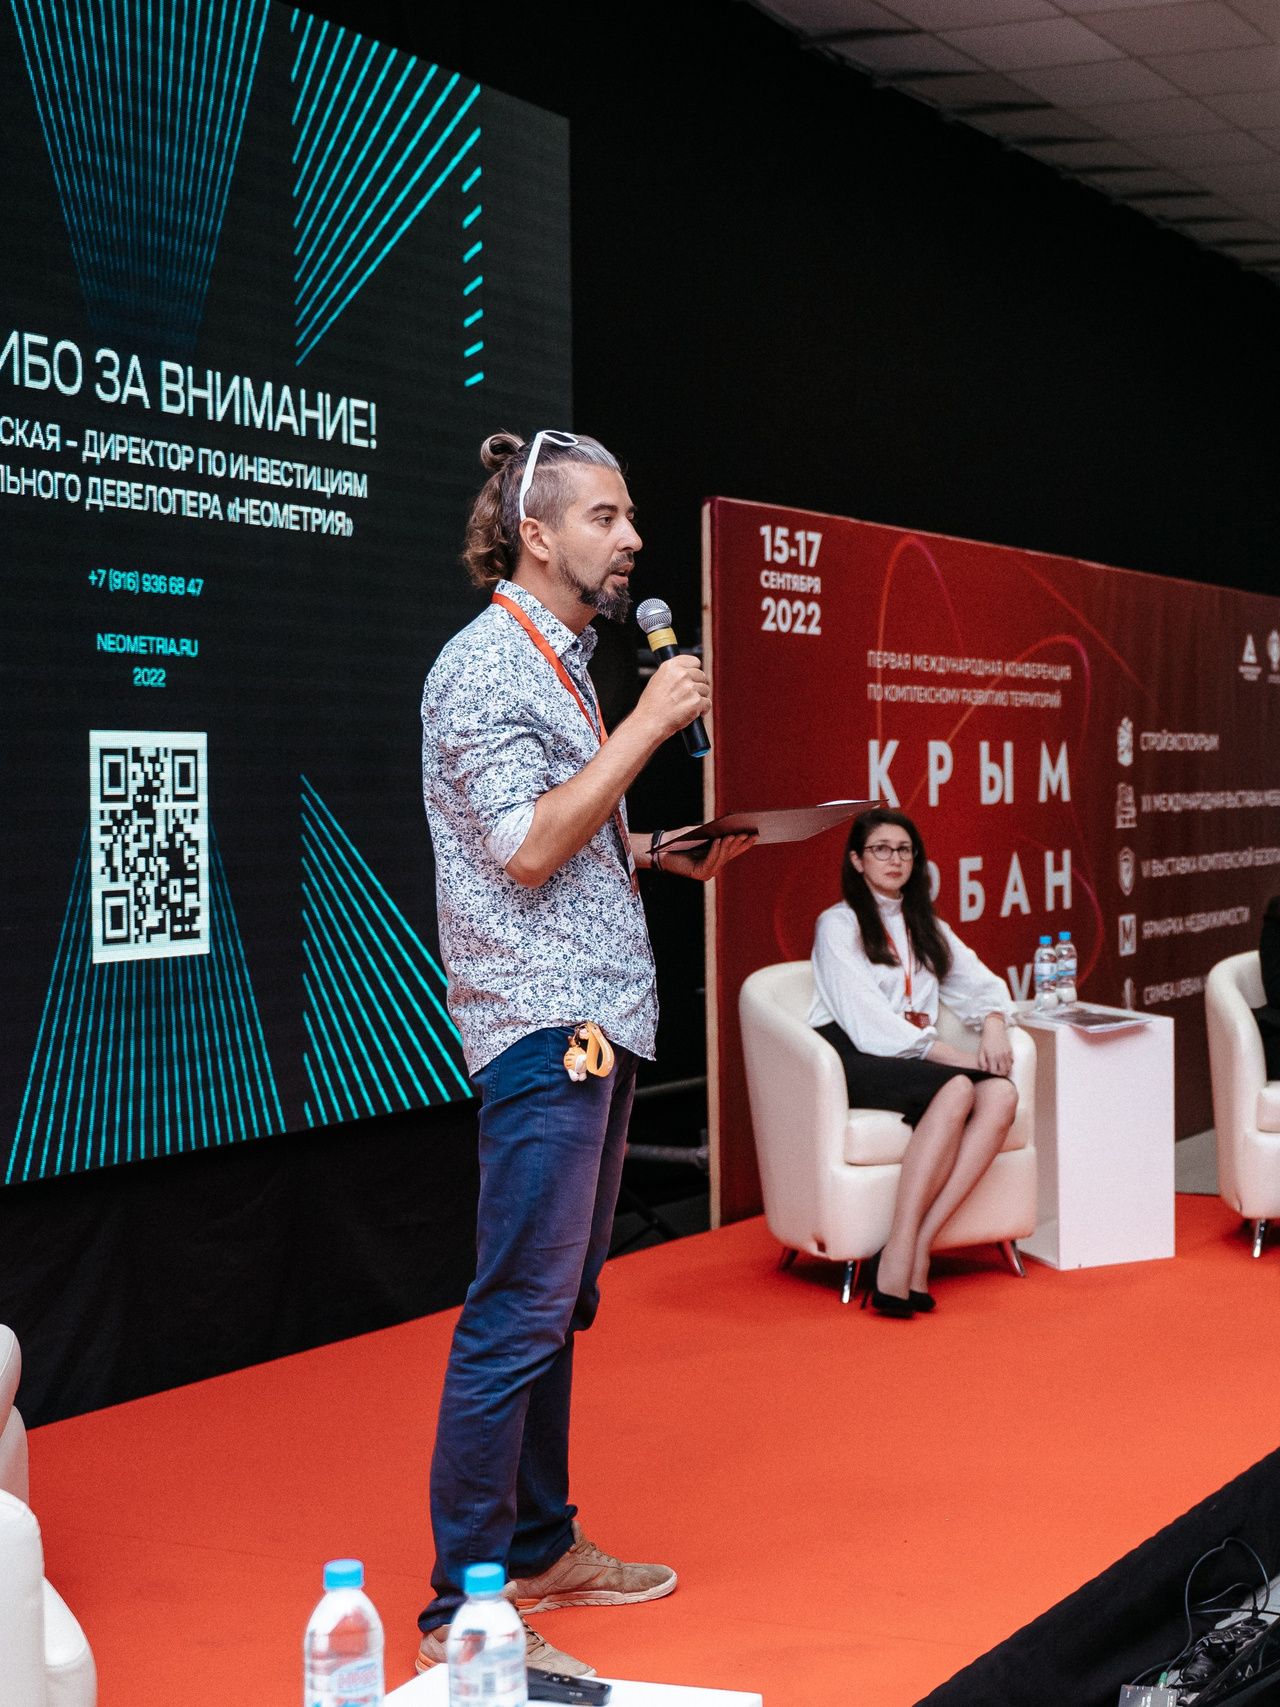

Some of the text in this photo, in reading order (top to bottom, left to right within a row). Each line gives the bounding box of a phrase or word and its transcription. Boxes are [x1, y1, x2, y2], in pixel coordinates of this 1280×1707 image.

[95, 347, 150, 409] ЗА
[160, 360, 377, 449] ВНИМАНИЕ!
[0, 415, 61, 452] СКАЯ
[82, 429, 194, 472] ДИРЕКТОР
[198, 447, 227, 478] ПО
[229, 452, 368, 499] ИНВЕСТИЦИЯМ
[85, 476, 224, 520] ДЕВЕЛОПЕРА
[227, 496, 354, 537] «НЕОМЕТРИЯ»
[760, 525, 822, 567] 15-17
[88, 568, 107, 588] +7
[109, 568, 139, 595] (916)
[141, 573, 167, 594] 936
[187, 578, 204, 596] 47
[760, 569, 821, 594] СЕНТЯБРЯ
[761, 597, 821, 635] 2022
[97, 633, 198, 657] NEOMETRIA.RU
[132, 666, 166, 687] 2022
[867, 650, 1072, 681] ПЕРВАЯ МЕЖДУНАРОДНАЯ КОНФЕРЕНЦИЯ
[867, 683, 883, 701] ПО
[884, 685, 960, 704] КОМПЛЕКСНОМУ
[868, 740, 1071, 808] КРЫМ
